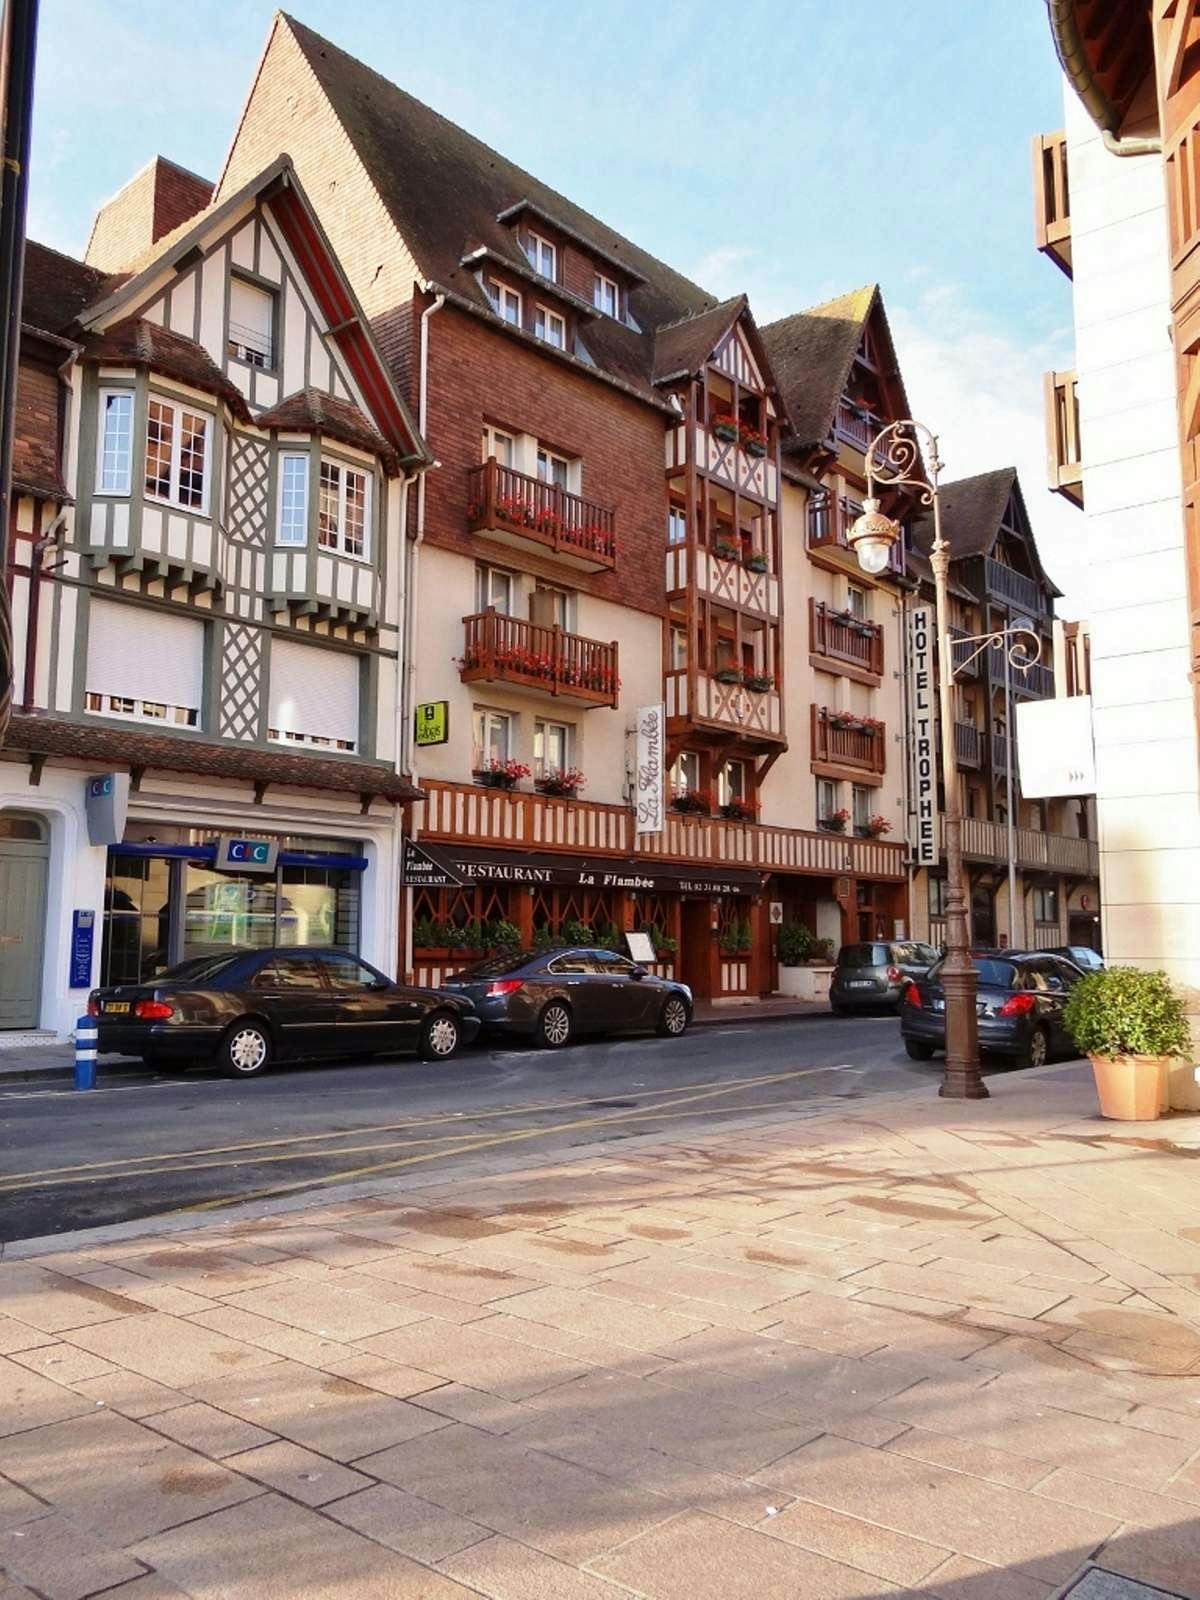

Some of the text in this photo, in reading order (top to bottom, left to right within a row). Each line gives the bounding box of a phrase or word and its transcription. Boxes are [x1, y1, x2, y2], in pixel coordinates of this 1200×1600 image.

[915, 611, 933, 860] HOTEL TROPHEE
[638, 797, 659, 828] La
[231, 844, 266, 860] CIC
[578, 872, 595, 885] La
